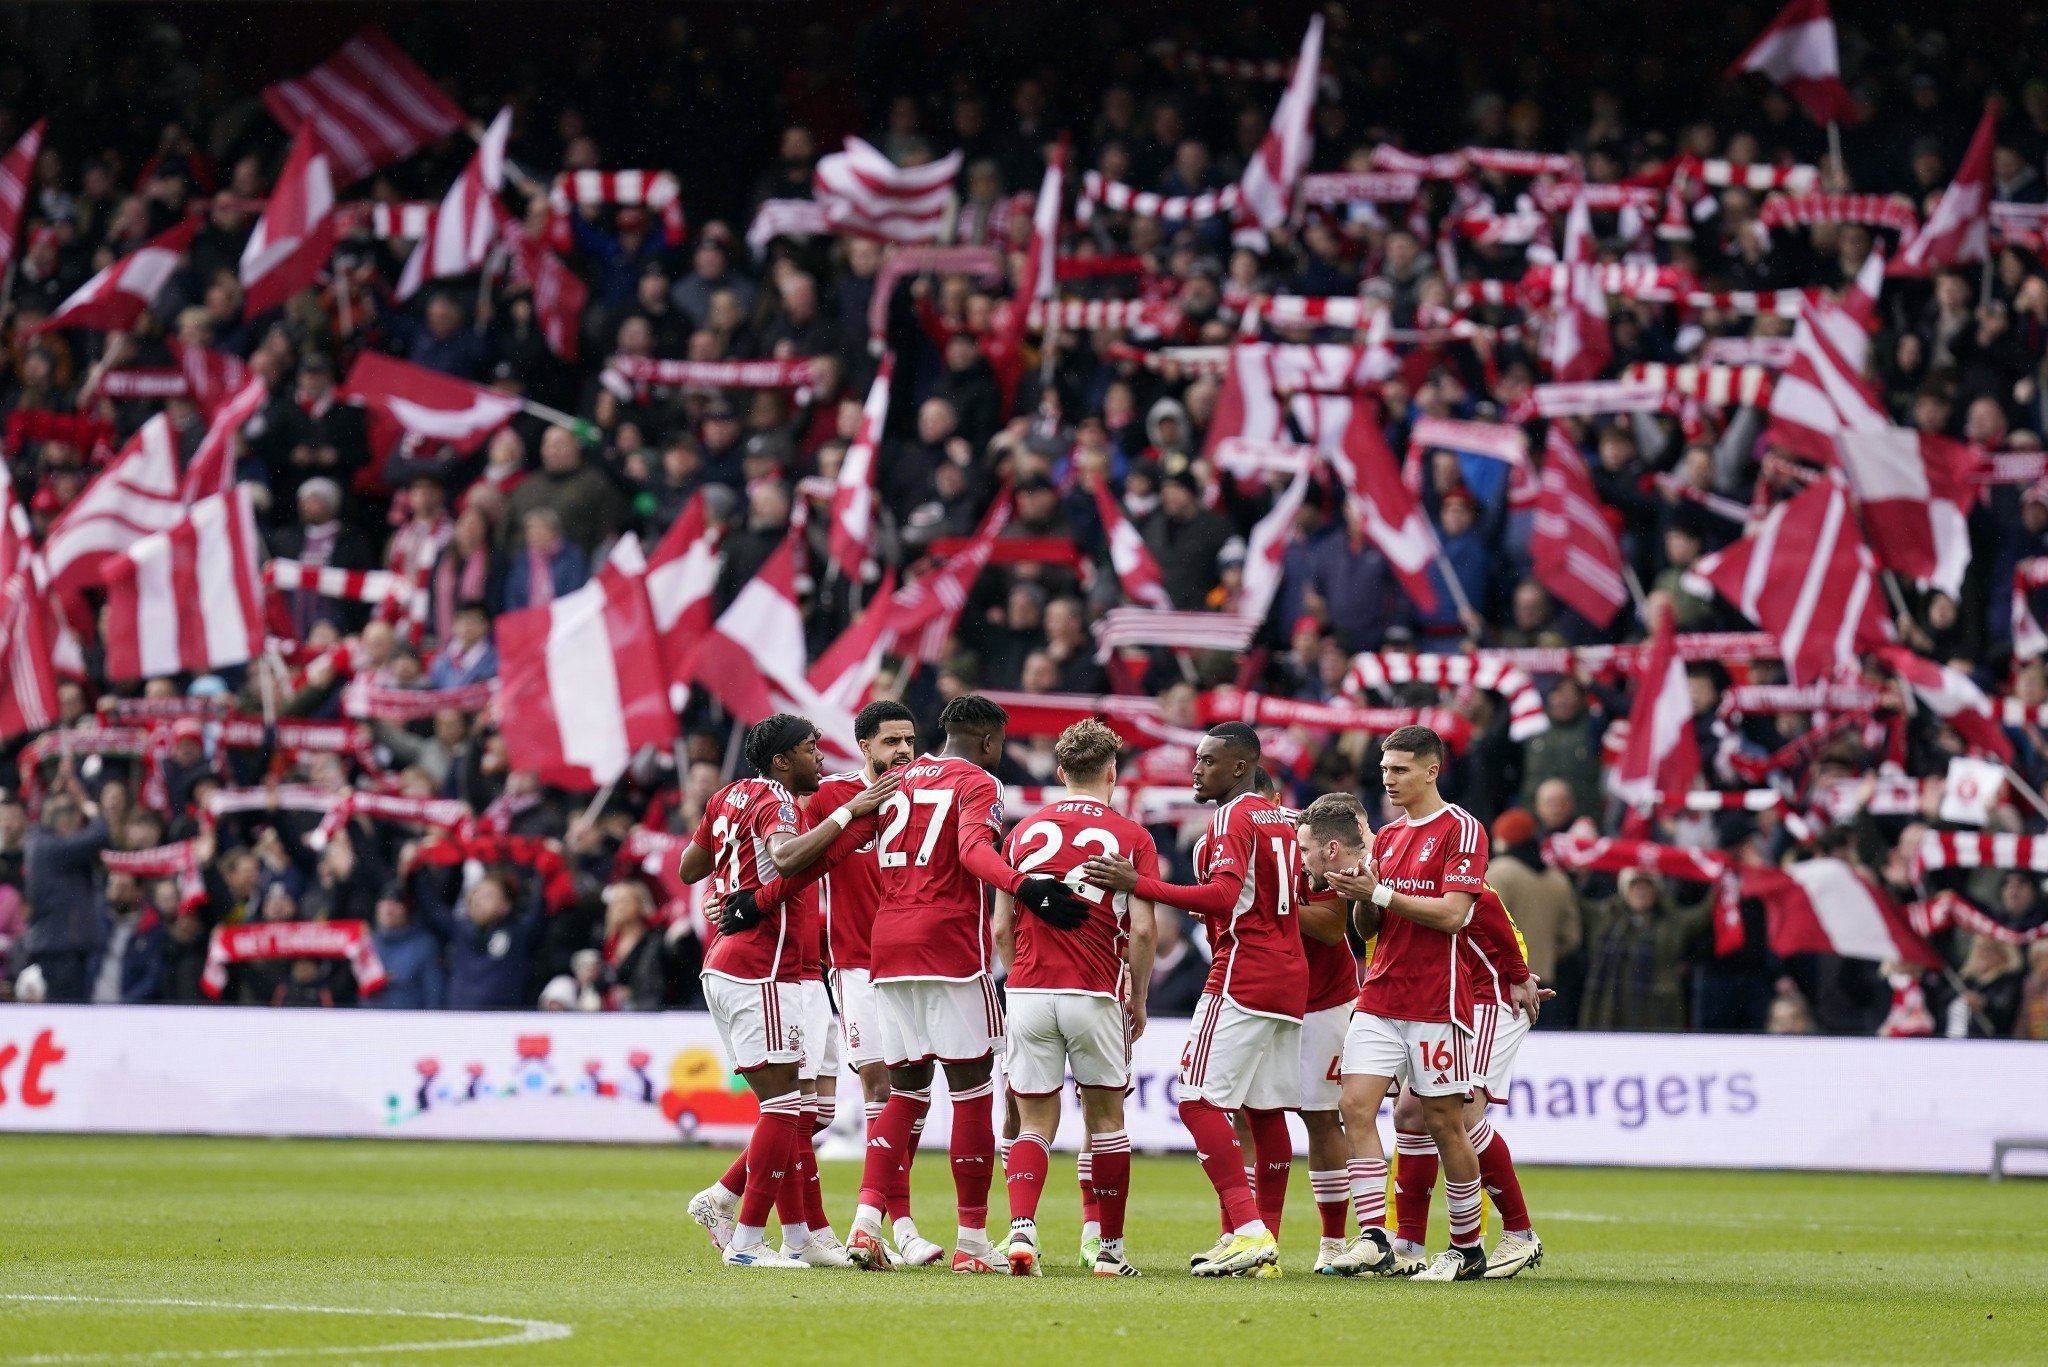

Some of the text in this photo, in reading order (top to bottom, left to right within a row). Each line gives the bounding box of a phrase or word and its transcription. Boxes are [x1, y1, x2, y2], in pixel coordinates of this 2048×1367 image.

[1056, 802, 1104, 817] YATES
[878, 788, 954, 868] 27
[1018, 820, 1120, 905] 22
[1444, 873, 1481, 885] ideagen
[1419, 1039, 1454, 1072] 16
[1485, 1071, 1758, 1130] hargers
[1092, 1187, 1118, 1196] FFC
